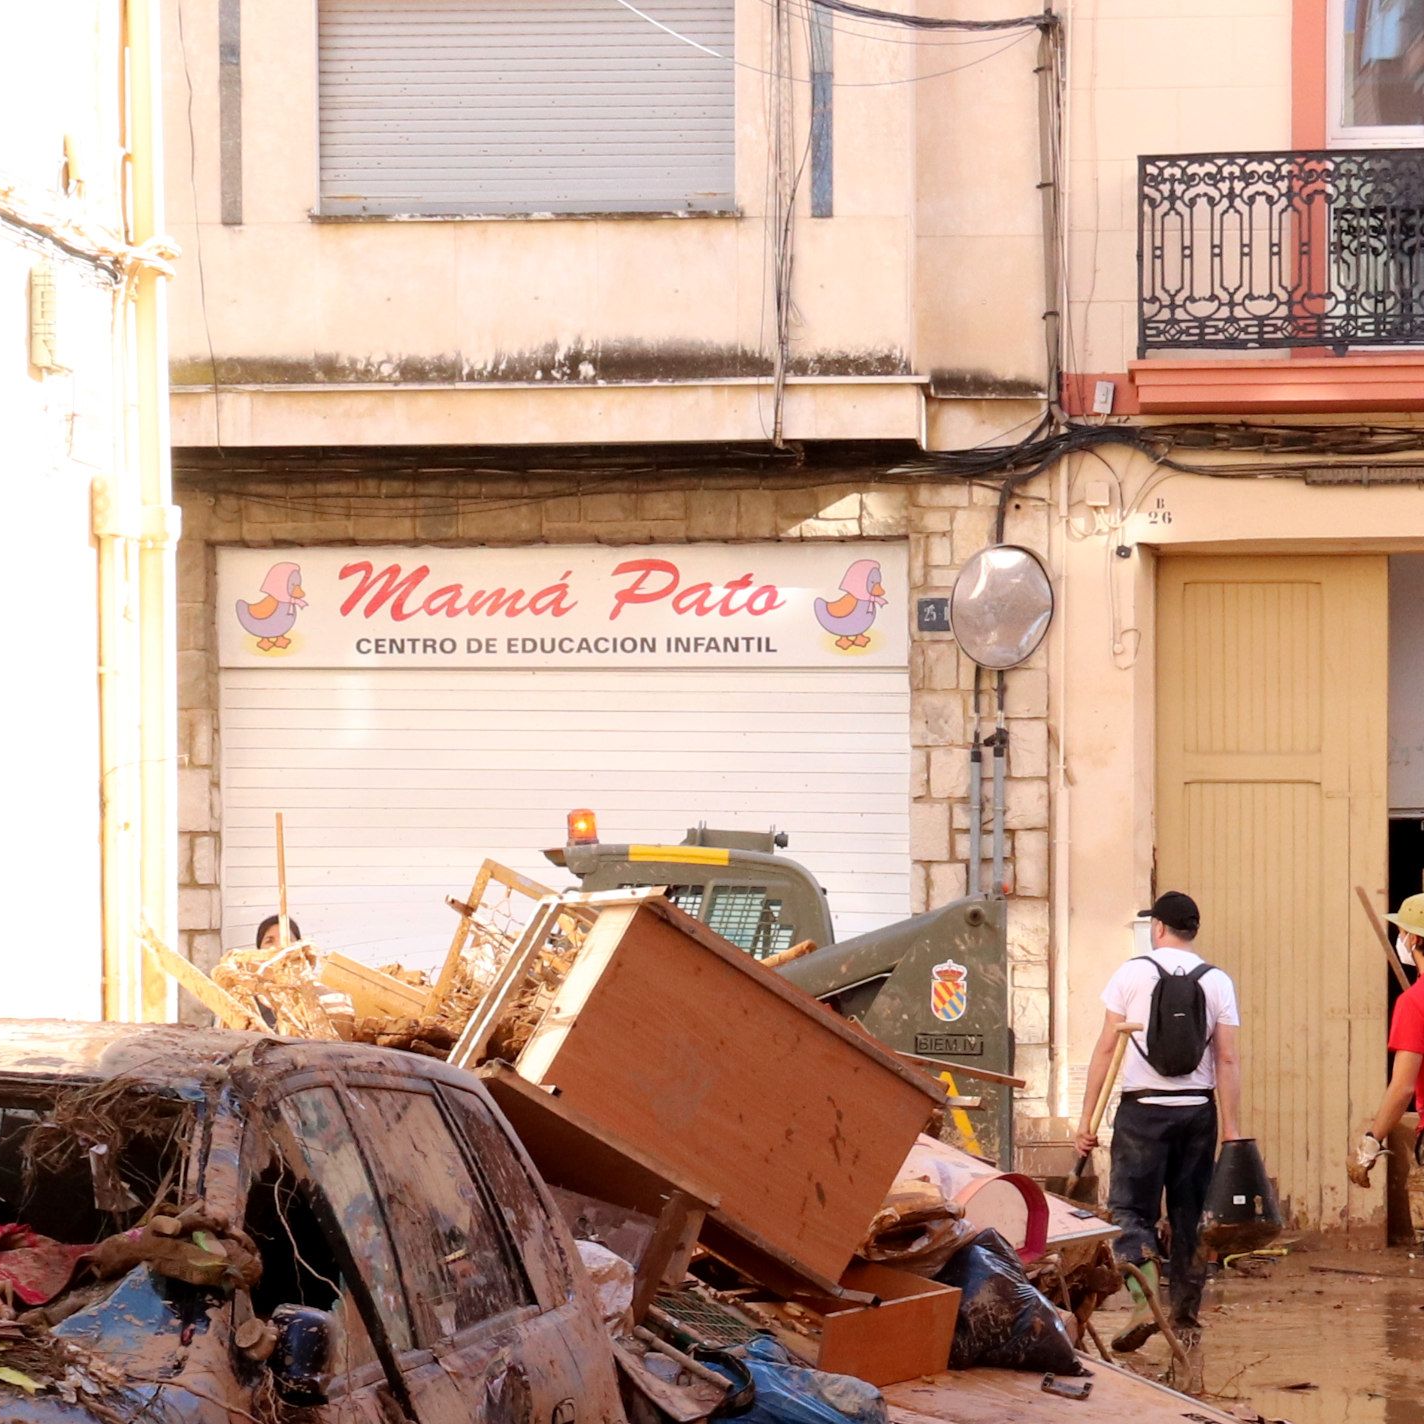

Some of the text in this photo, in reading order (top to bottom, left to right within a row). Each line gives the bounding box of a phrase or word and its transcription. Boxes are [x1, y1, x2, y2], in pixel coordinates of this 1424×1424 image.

[1148, 511, 1172, 524] 26
[338, 558, 786, 622] Mamá Pato
[356, 636, 778, 655] CENTRO DE EDUCACION INFANTIL
[919, 1038, 958, 1052] BIEM
